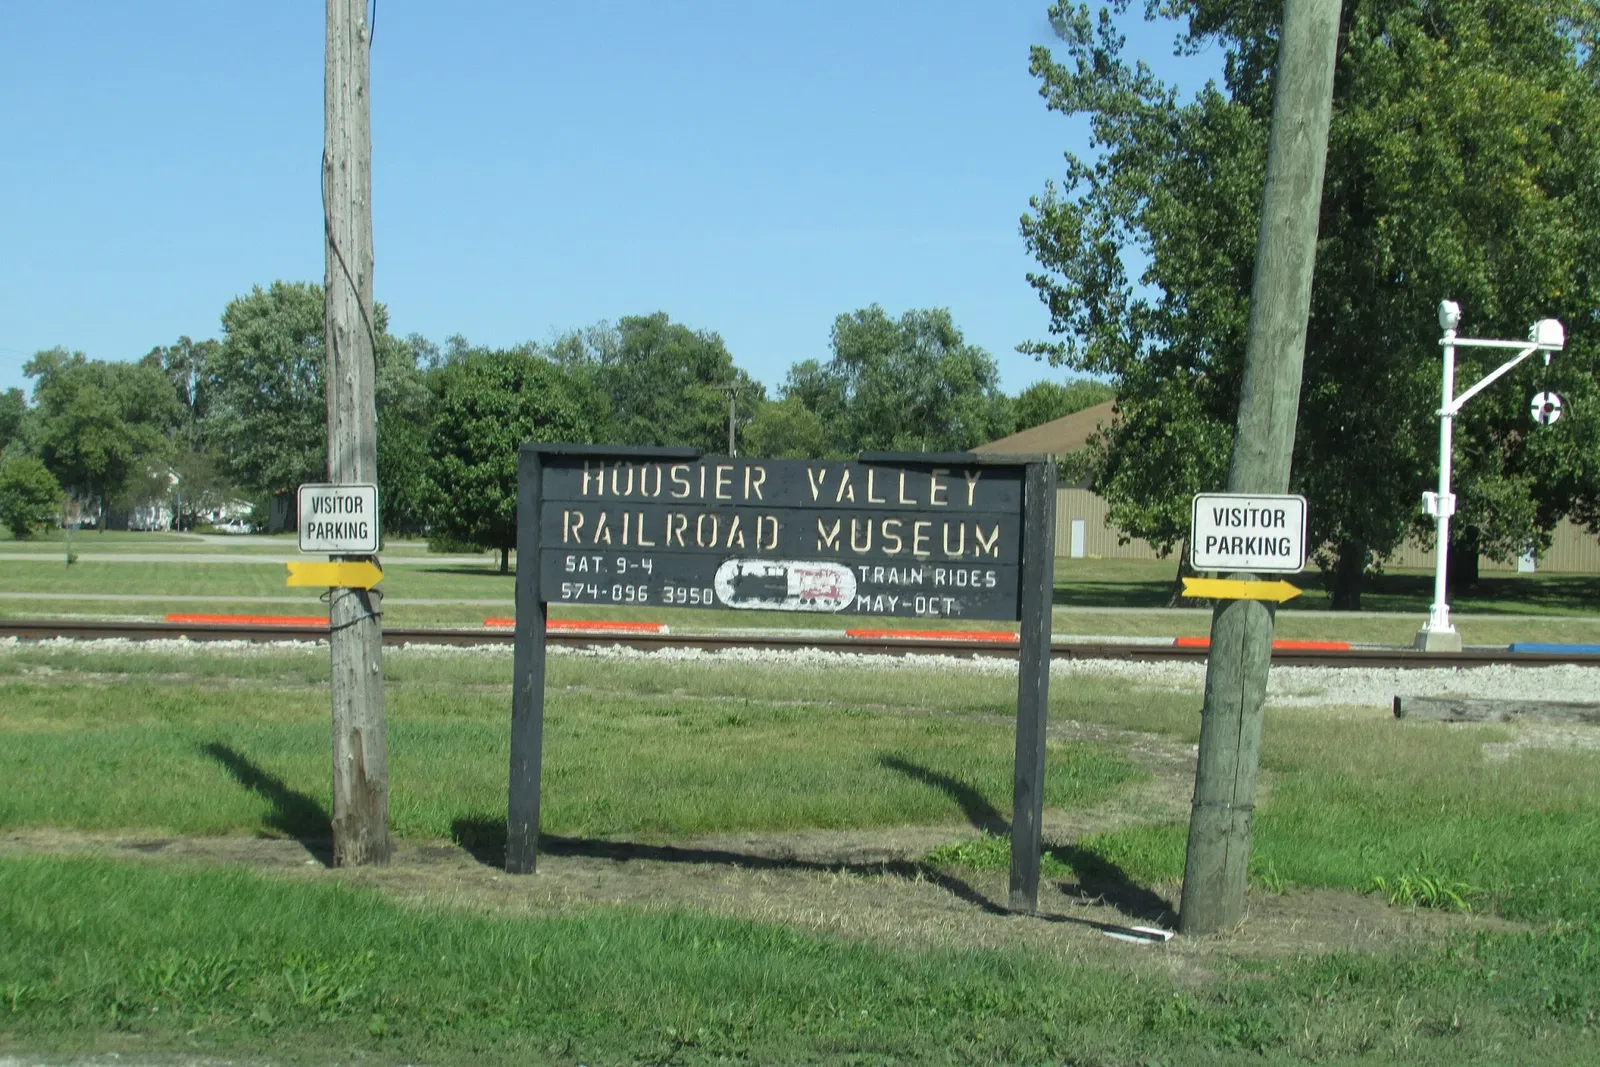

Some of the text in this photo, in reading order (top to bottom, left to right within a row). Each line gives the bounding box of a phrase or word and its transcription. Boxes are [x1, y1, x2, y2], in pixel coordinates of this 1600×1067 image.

[583, 460, 982, 506] HOOSIER VALLEY
[312, 496, 363, 513] VISITOR
[1213, 507, 1285, 527] VISITOR
[307, 521, 368, 540] PARKING
[563, 510, 999, 558] RAILROAD MUSEUM
[1205, 535, 1291, 557] PARKING
[565, 555, 653, 575] SAT. 9-4
[858, 565, 997, 588] TRAIN RIDES
[663, 585, 714, 605] 3950
